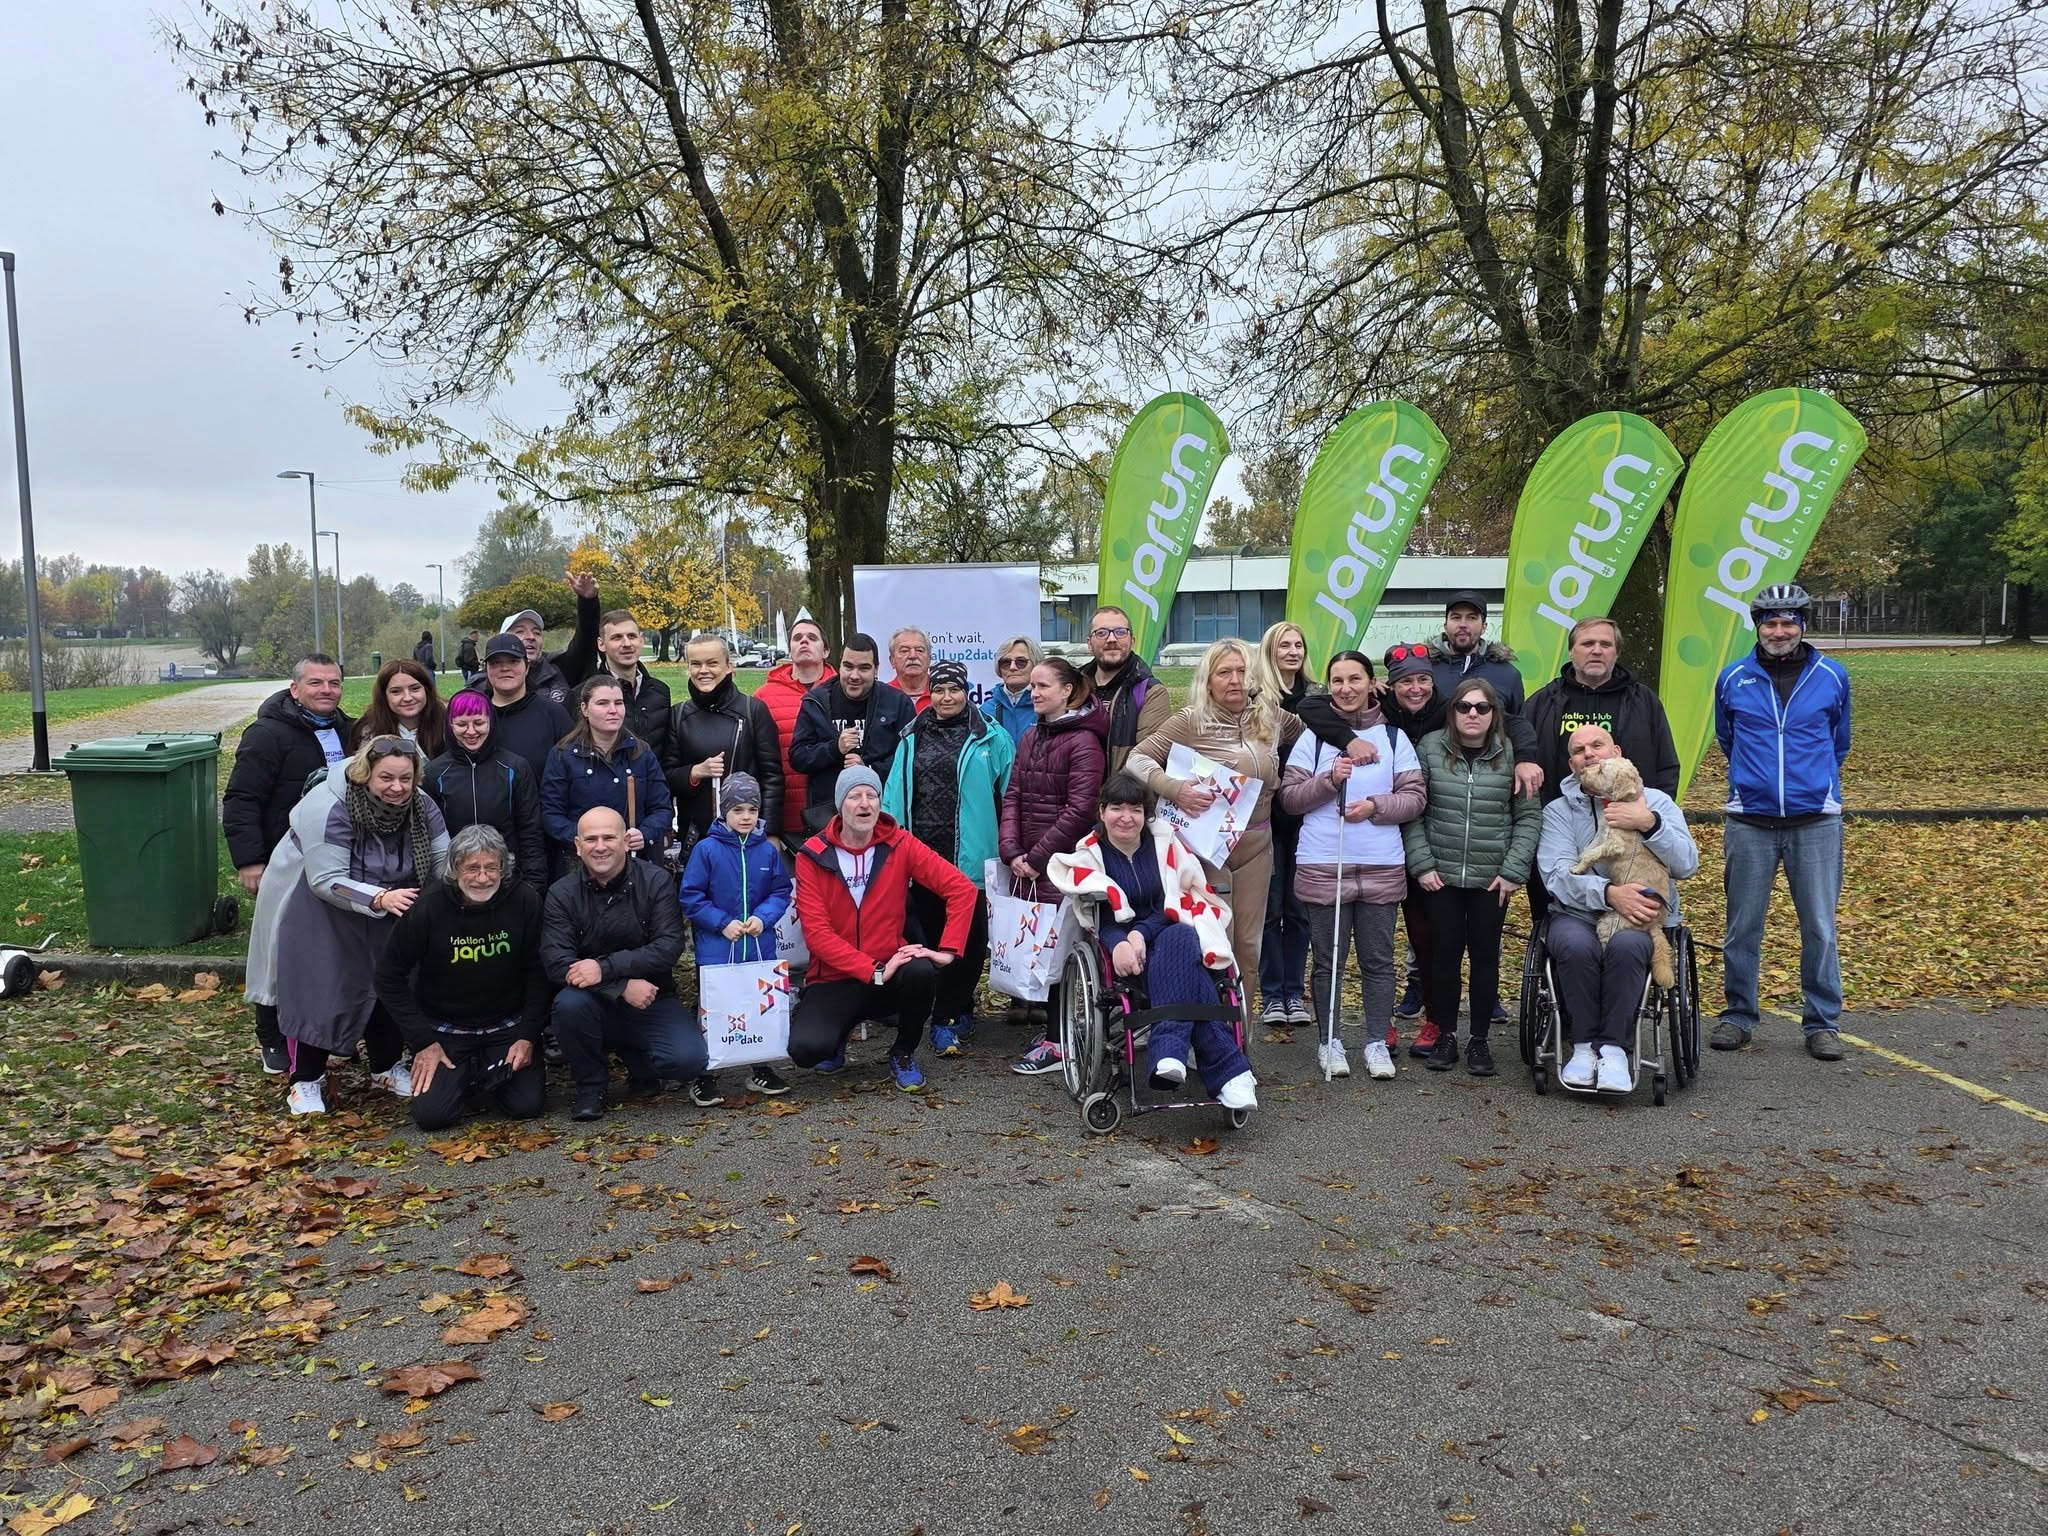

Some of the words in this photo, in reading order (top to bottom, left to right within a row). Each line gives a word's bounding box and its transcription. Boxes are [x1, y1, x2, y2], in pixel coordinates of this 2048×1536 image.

[1123, 432, 1208, 623] jarun
[1314, 443, 1425, 638] jarun
[929, 632, 953, 643] on't
[956, 632, 985, 644] wait,
[930, 649, 945, 660] all
[450, 941, 511, 963] jarun
